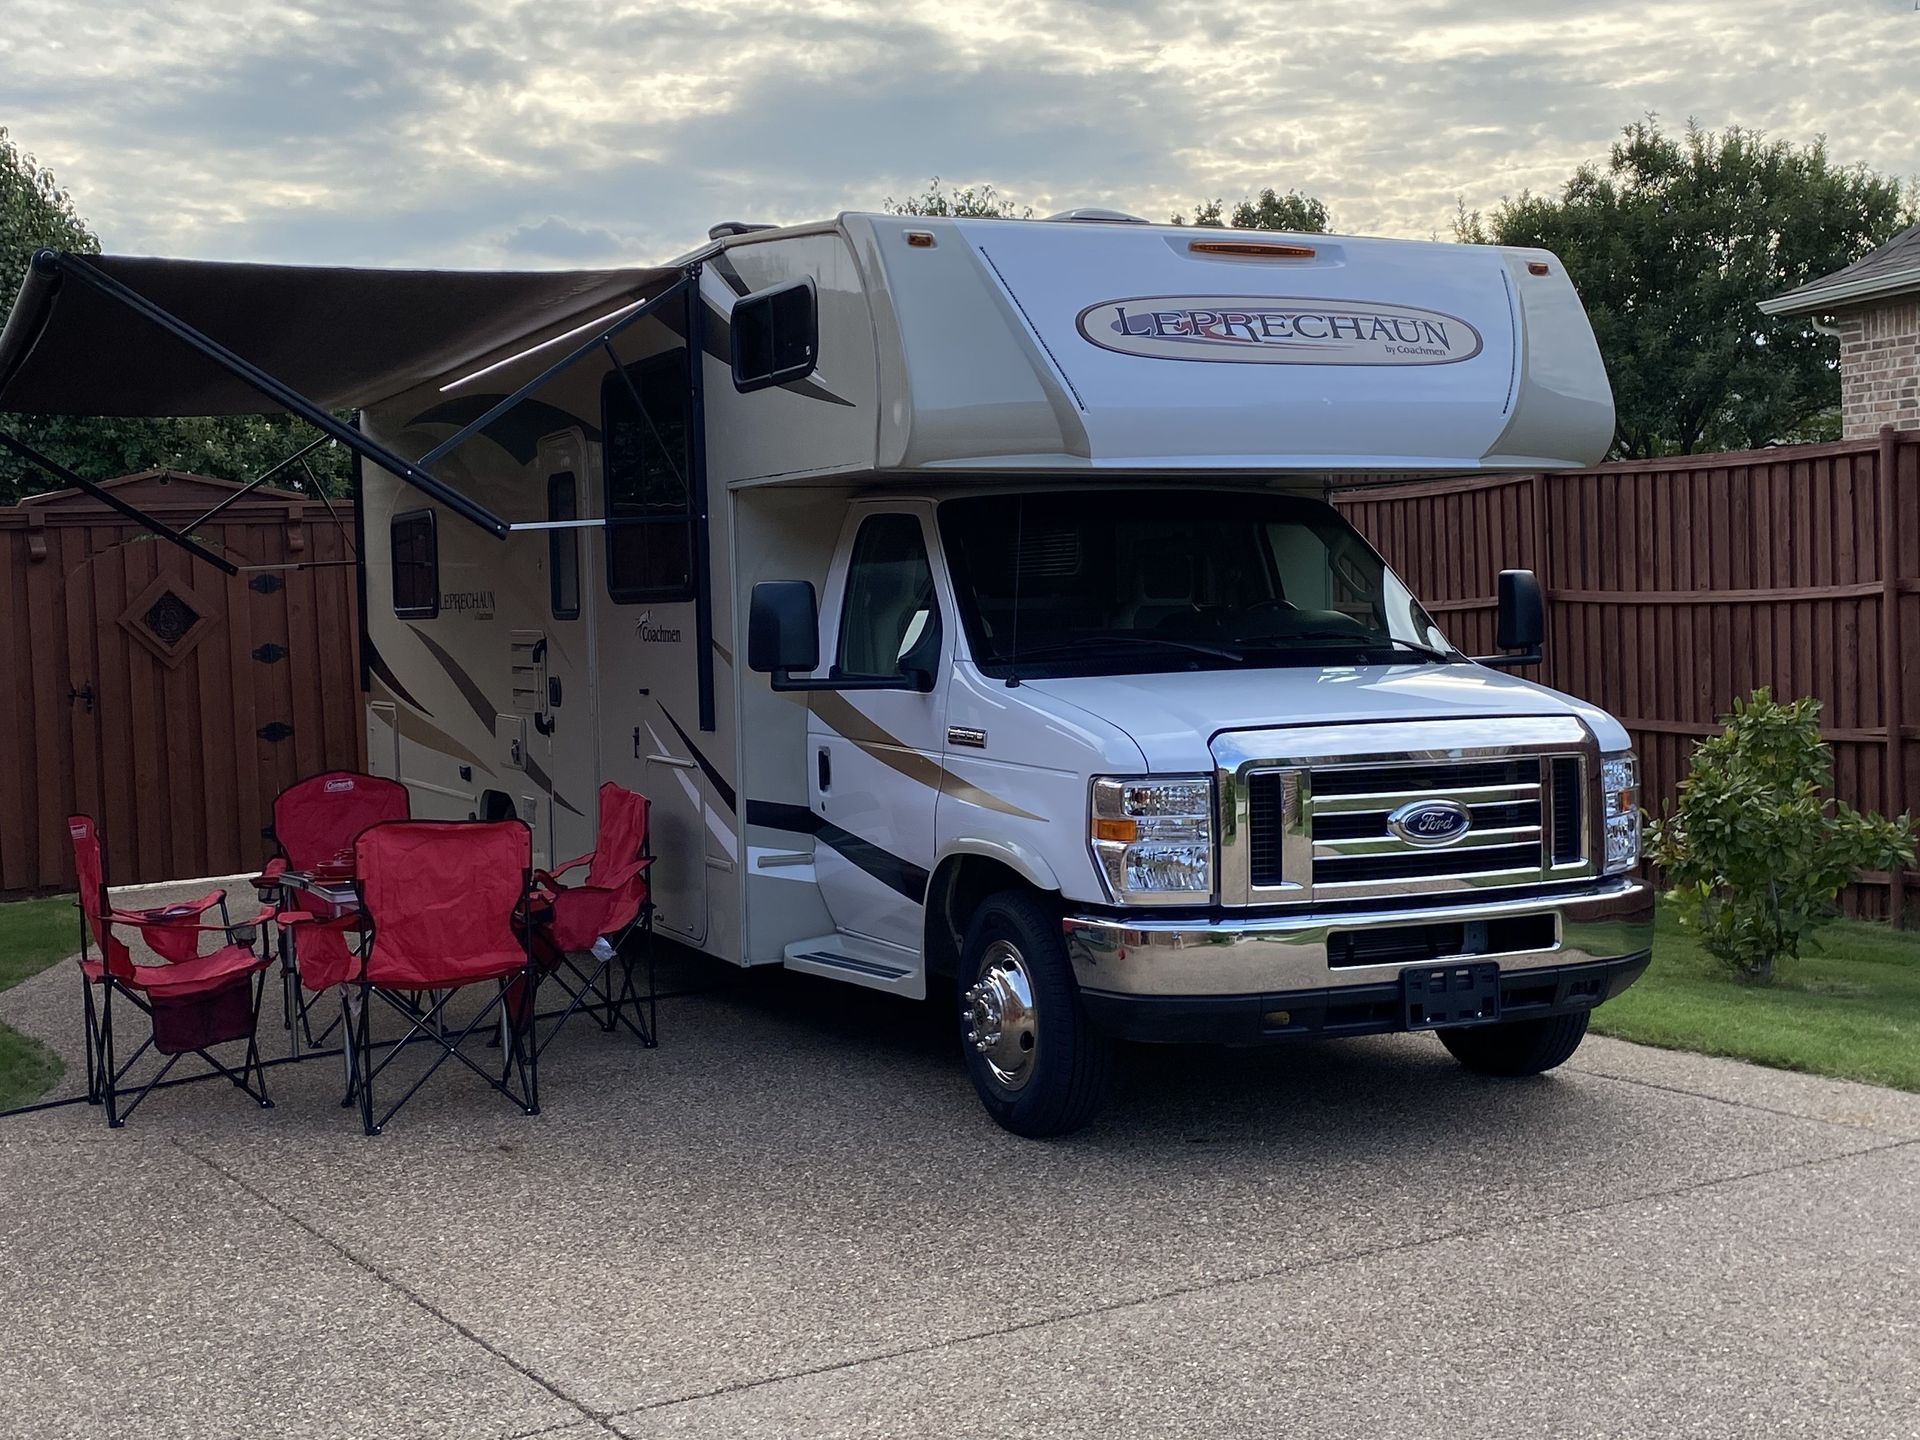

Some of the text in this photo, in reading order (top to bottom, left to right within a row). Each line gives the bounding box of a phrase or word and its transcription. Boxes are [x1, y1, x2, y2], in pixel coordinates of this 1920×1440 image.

[1115, 307, 1451, 351] LEPRECHAUN
[1385, 344, 1446, 356] by Coachmen
[439, 591, 496, 613] LEPRECHAUN
[642, 625, 681, 642] Coachmen
[1418, 812, 1454, 831] Ford
